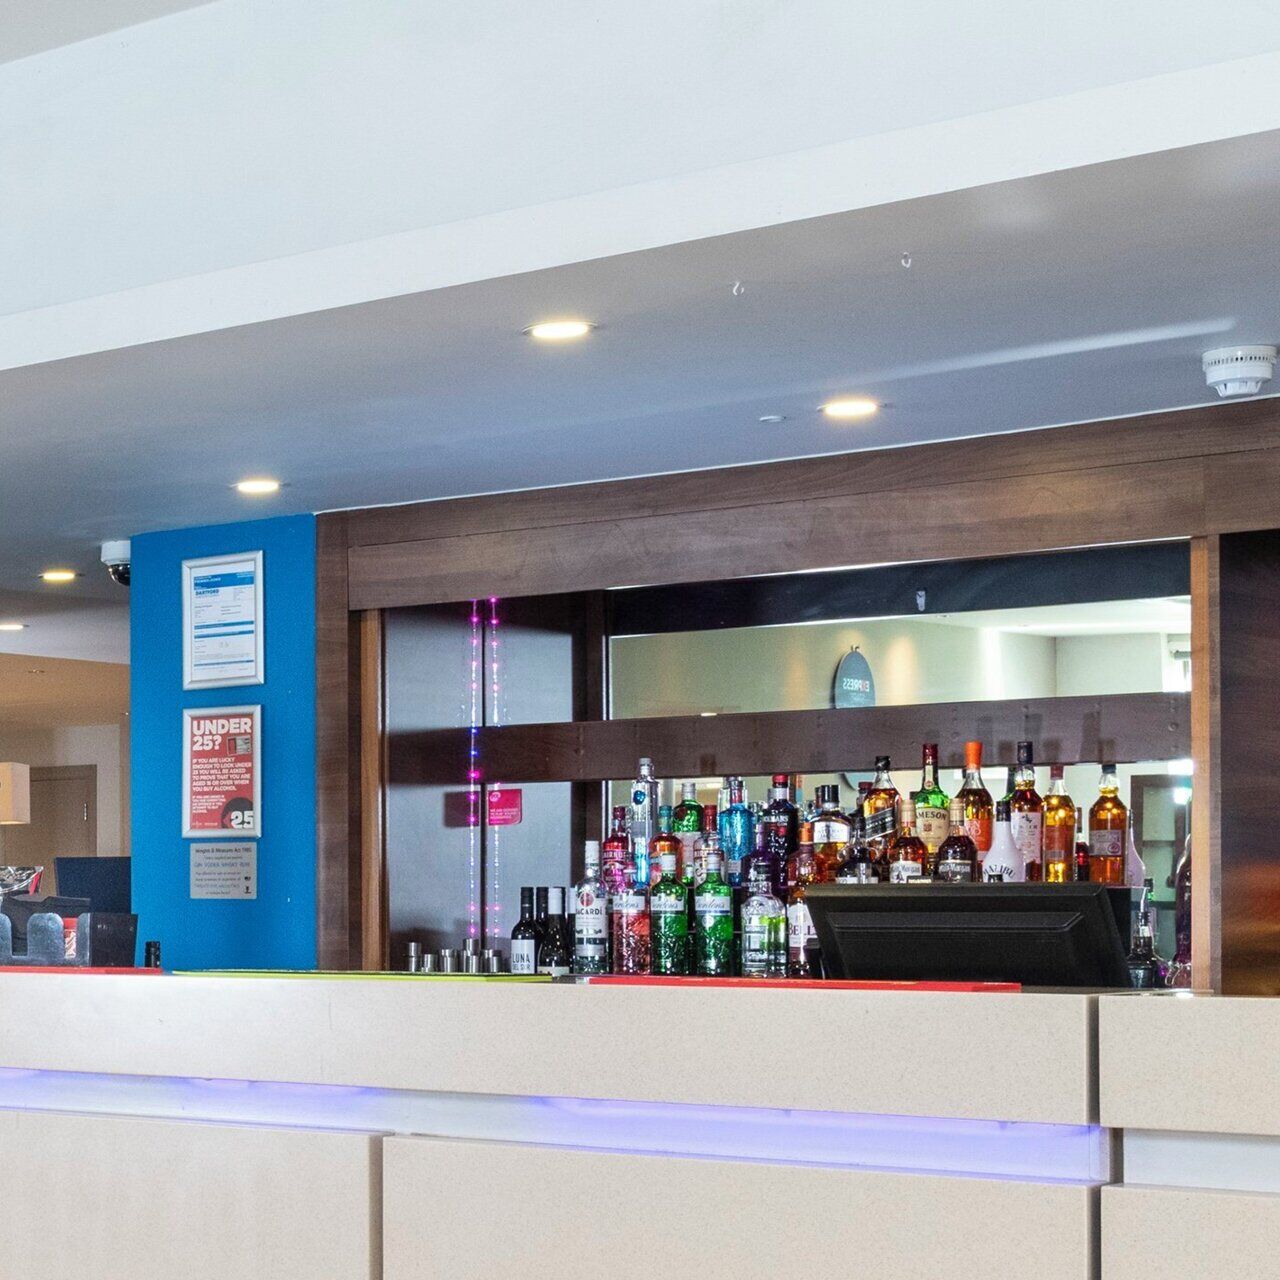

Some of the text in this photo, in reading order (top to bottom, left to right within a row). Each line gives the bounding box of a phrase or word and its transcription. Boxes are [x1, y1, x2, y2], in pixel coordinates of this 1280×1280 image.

[192, 718, 252, 735] UNDER
[192, 735, 222, 751] 25?
[231, 810, 254, 829] 25
[916, 810, 947, 820] AMESON
[512, 953, 531, 964] LUNA
